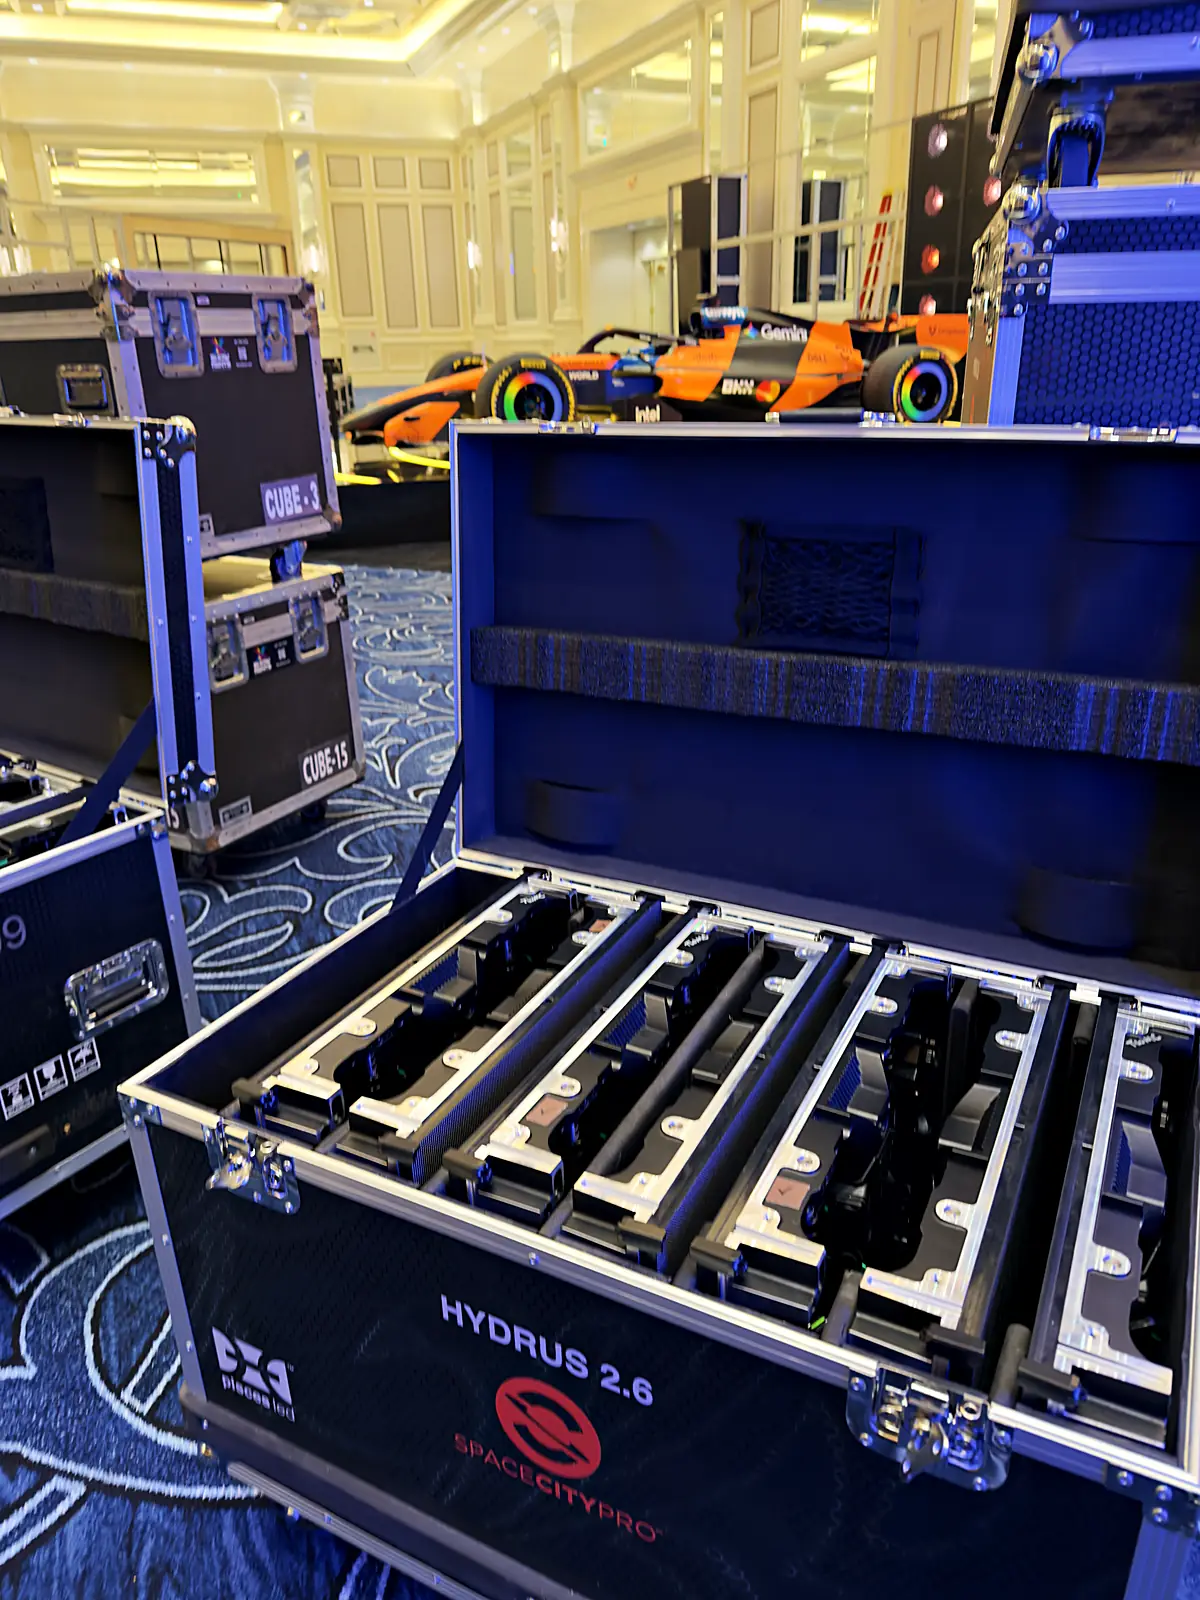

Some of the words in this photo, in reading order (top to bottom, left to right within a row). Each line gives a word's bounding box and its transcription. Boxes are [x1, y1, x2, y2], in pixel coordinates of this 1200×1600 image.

[761, 323, 808, 342] Gemini
[302, 740, 348, 785] CUBE-15
[0, 914, 27, 950] 9
[441, 1294, 589, 1379] HYDRUS
[600, 1363, 654, 1407] 2.6
